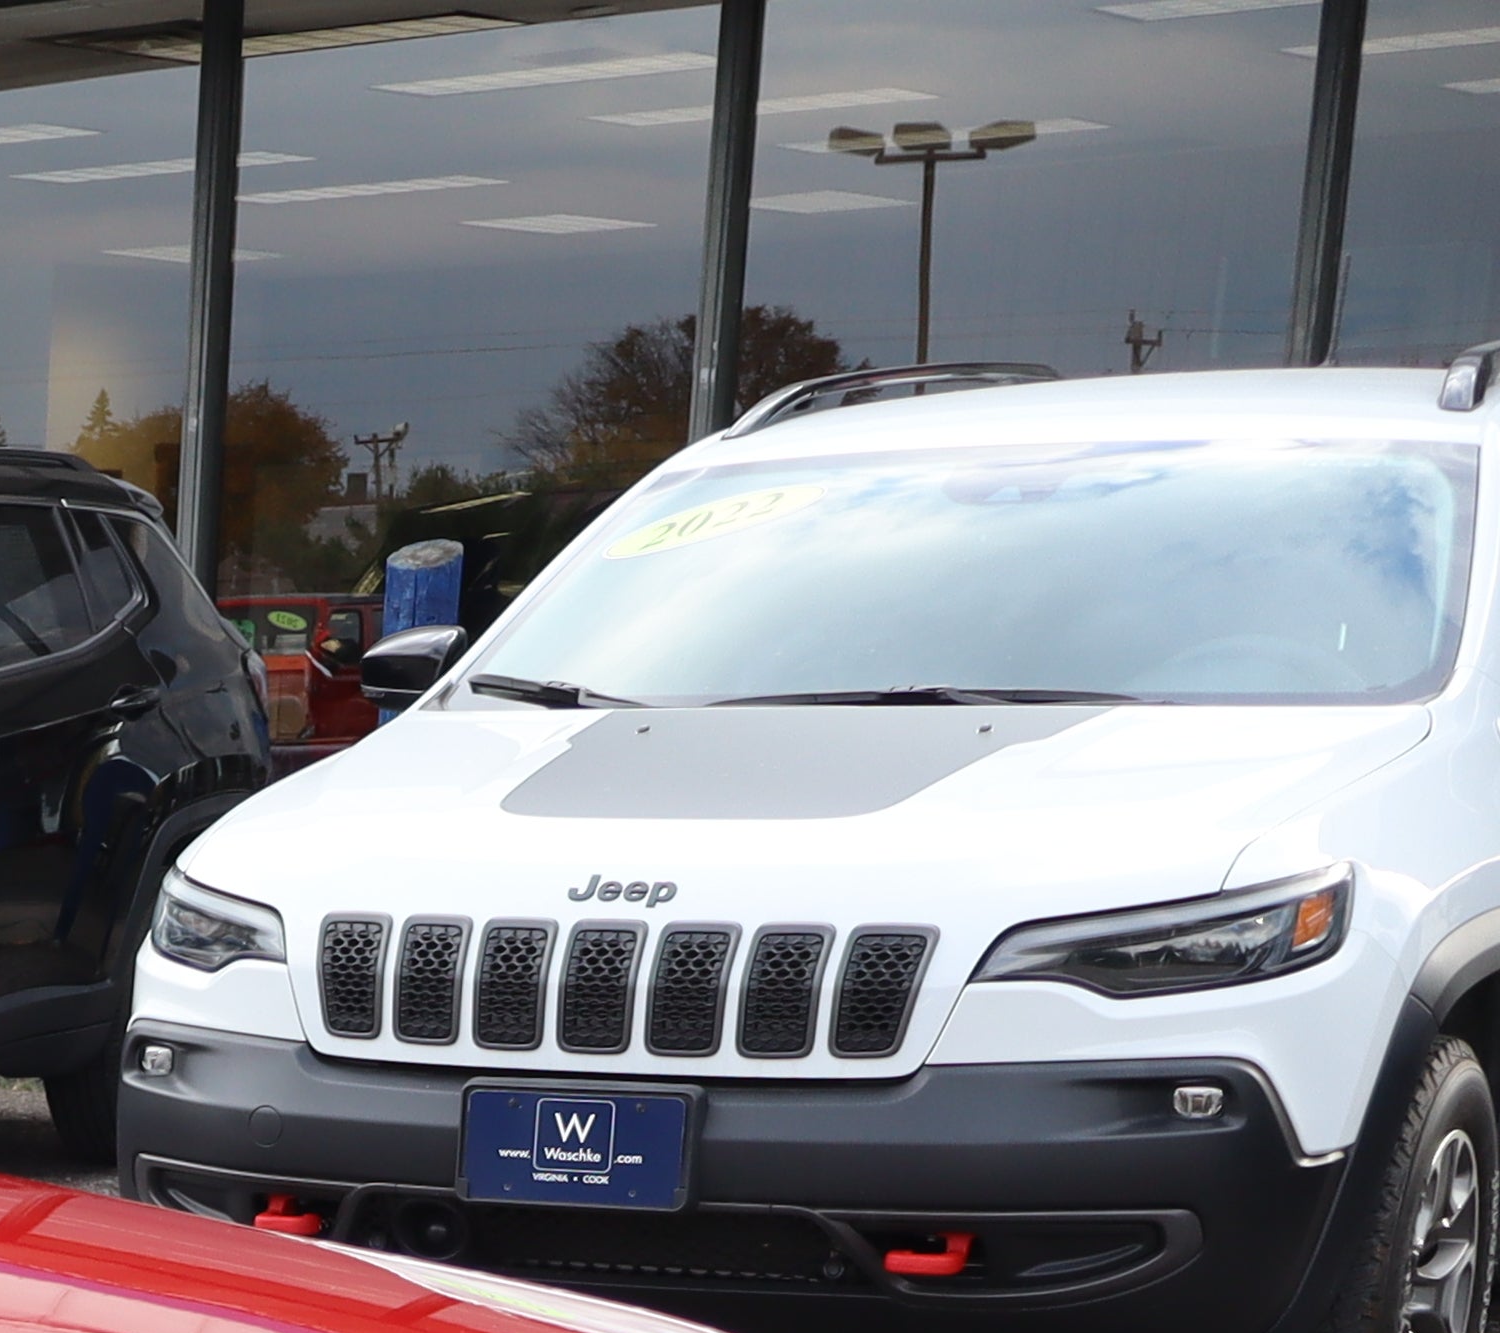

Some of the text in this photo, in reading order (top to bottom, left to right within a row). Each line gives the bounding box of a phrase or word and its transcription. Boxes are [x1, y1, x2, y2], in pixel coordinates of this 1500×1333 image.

[637, 492, 785, 551] 2022
[567, 874, 678, 908] Jeep
[554, 1111, 596, 1144] W
[543, 1146, 602, 1163] Waschke
[613, 1154, 643, 1165] .com
[583, 1174, 610, 1185] COOK
